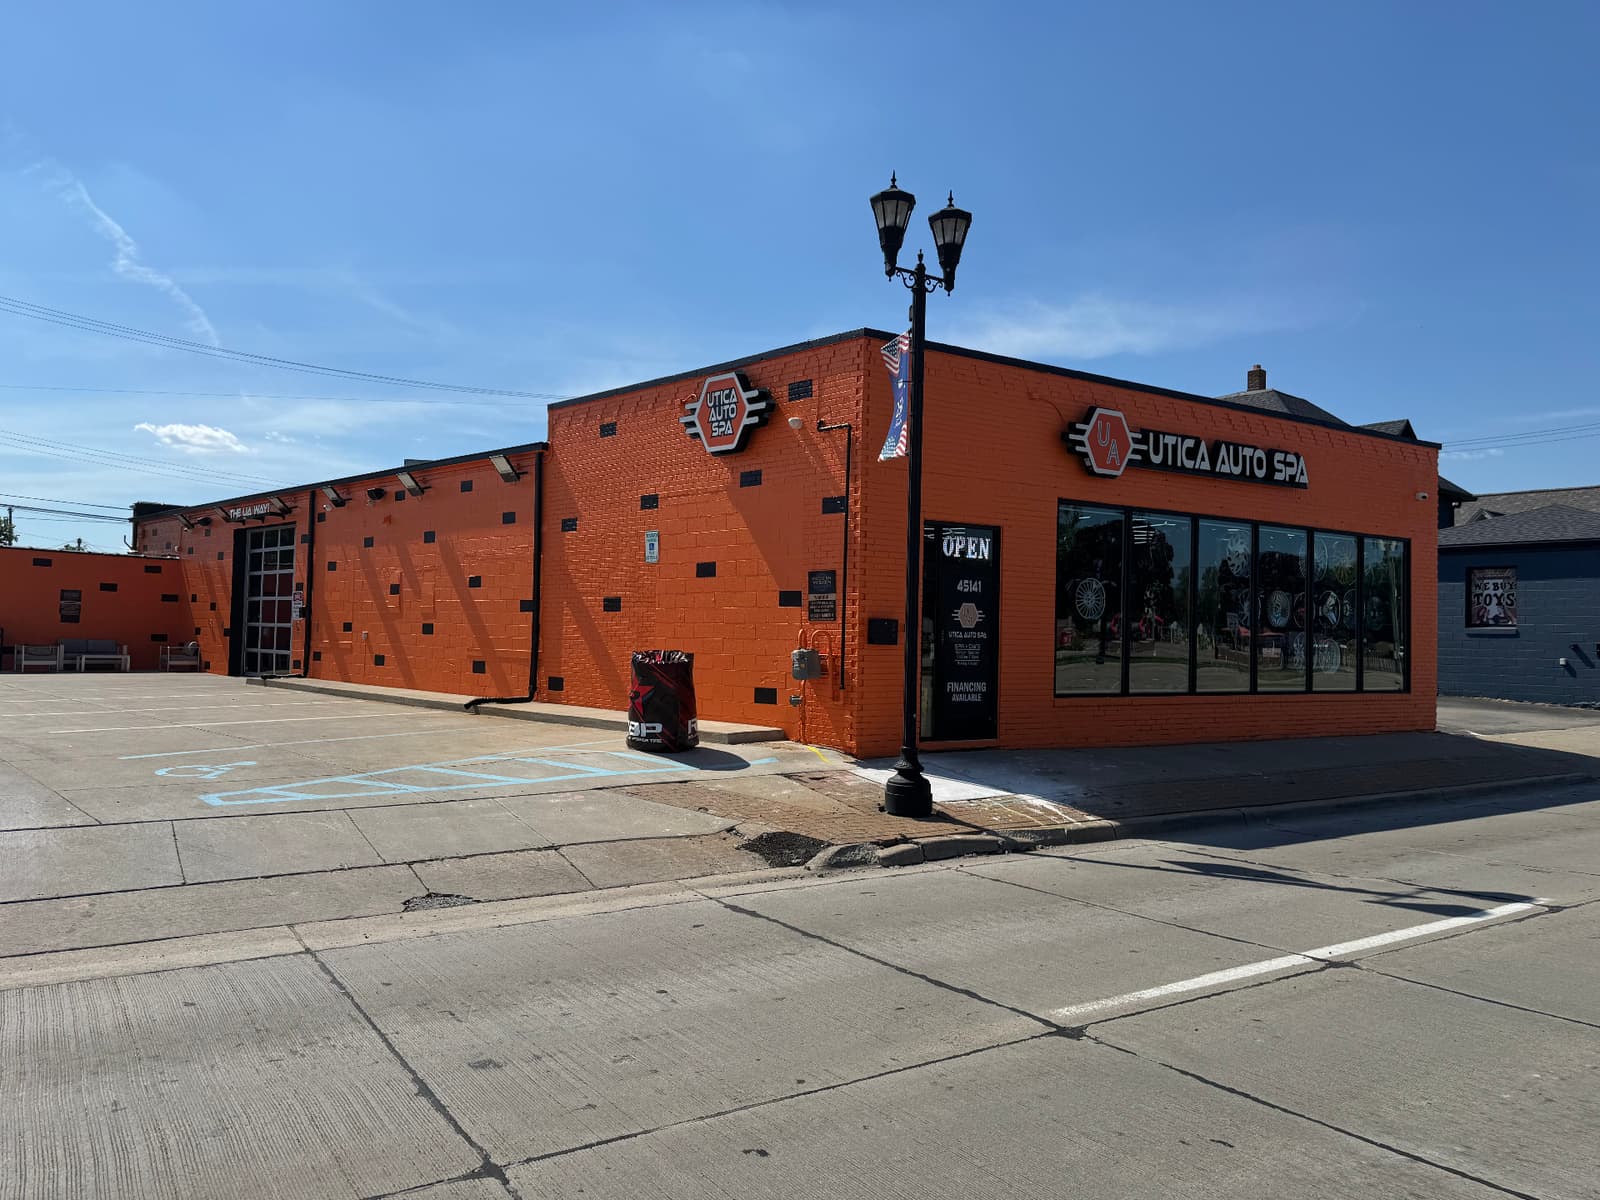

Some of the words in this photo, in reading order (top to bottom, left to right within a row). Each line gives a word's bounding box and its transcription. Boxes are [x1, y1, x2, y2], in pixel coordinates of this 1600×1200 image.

[707, 387, 738, 408] UTICA
[709, 403, 737, 422] AUTO
[711, 420, 733, 437] SPA
[1149, 432, 1211, 471] UTICA
[1215, 442, 1267, 478] AUTO
[1273, 452, 1309, 484] SPA
[942, 535, 991, 560] OPEN
[956, 579, 982, 593] 45141
[1474, 582, 1490, 591] WE
[1492, 581, 1515, 591] BUY
[1473, 592, 1515, 607] TOYS
[946, 681, 987, 693] FINANCING
[951, 693, 982, 702] AVAILABLE
